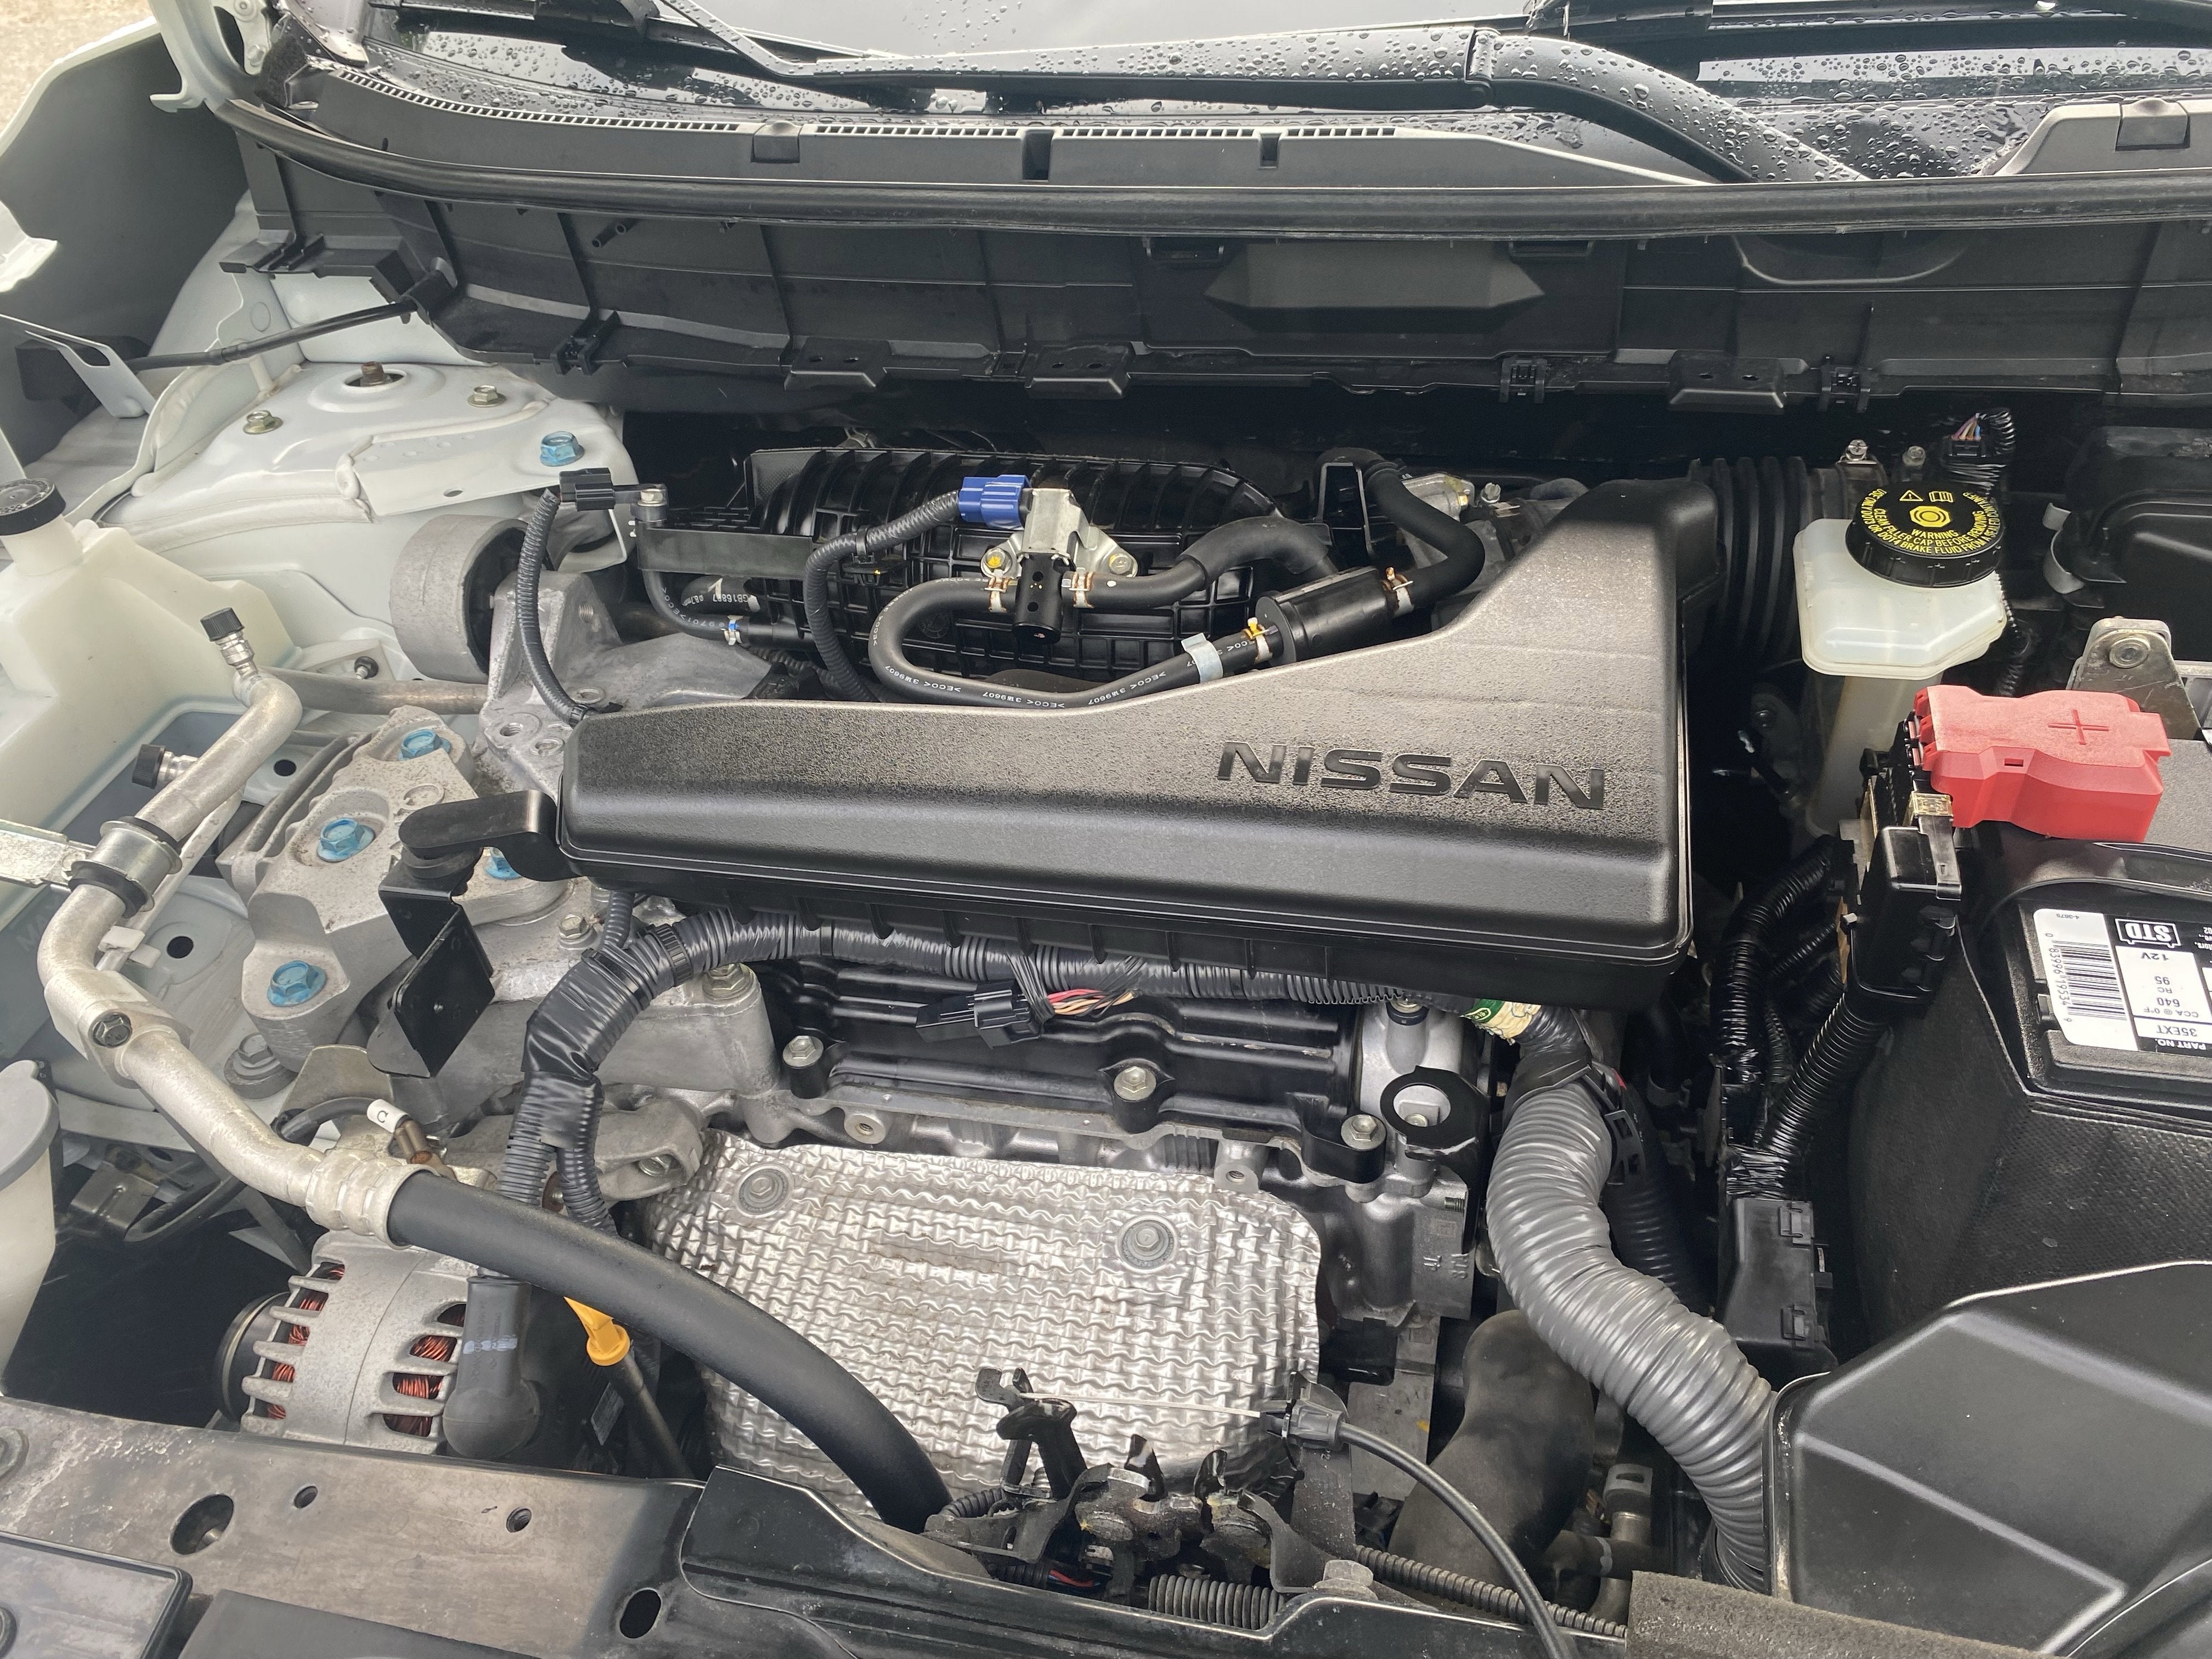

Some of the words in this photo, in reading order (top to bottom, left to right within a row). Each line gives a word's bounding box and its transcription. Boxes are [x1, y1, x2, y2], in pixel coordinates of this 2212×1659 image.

[1869, 489, 1887, 499] USE
[1962, 492, 1999, 517] CONTAINER
[1868, 524, 1883, 533] OR
[1874, 508, 1891, 526] CLEAN
[1883, 525, 1912, 541] FILLER
[1913, 537, 1933, 546] CAP
[1935, 534, 1974, 547] BEFORE
[1967, 511, 1987, 538] REMOVING
[1984, 518, 2001, 538] SEALED
[1911, 528, 1959, 540] WARNING
[1899, 541, 1932, 554] BRAKE
[1934, 546, 1962, 554] FLUID
[1960, 538, 1987, 552] FROM
[1217, 740, 1605, 810] NISSAN
[2125, 922, 2171, 942] STD
[2140, 952, 2169, 961] 12V
[2049, 948, 2061, 975] 83996
[2055, 979, 2070, 1006] 19534
[2154, 976, 2170, 985] 95
[2157, 997, 2180, 1007] 640
[2155, 1024, 2198, 1037] 35EXT
[2155, 1039, 2176, 1048] NO.
[2176, 1040, 2207, 1050] PART
